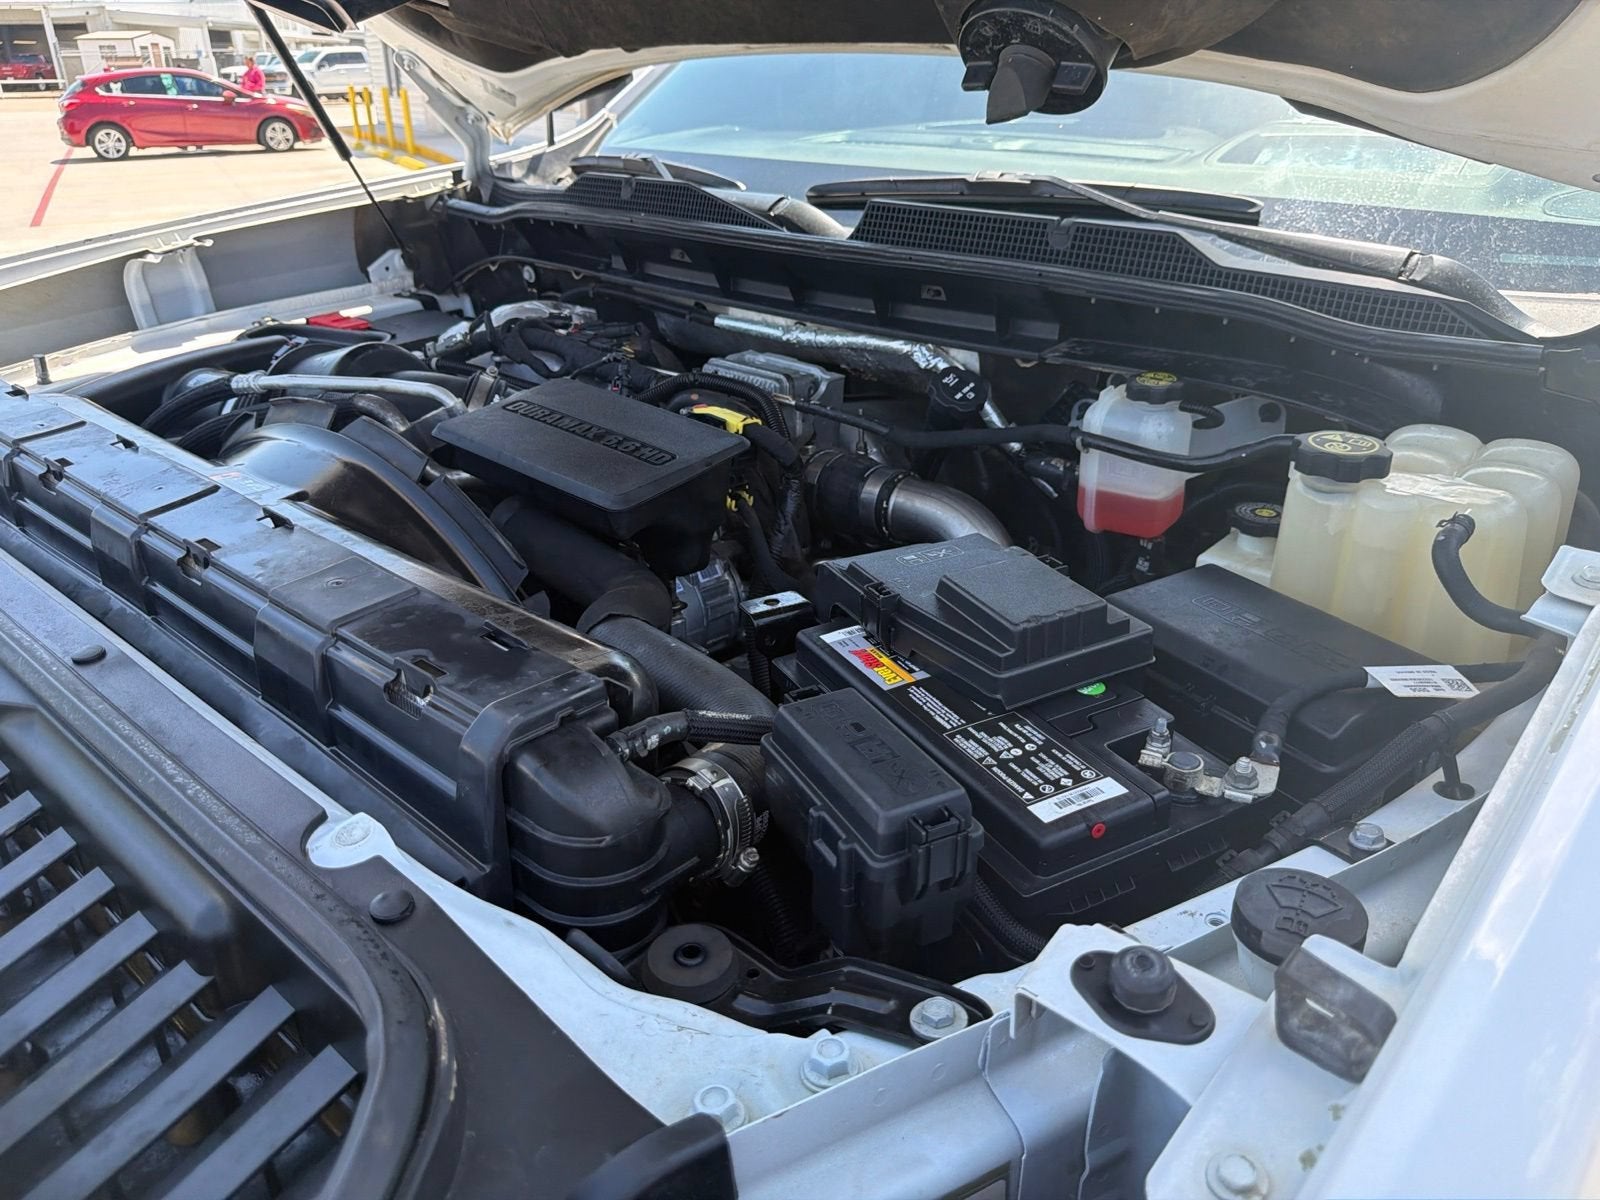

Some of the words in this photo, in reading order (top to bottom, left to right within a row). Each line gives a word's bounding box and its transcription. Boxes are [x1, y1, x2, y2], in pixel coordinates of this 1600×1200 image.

[506, 401, 600, 439] DURAMAX
[602, 434, 641, 453] 6.6
[848, 648, 904, 685] EverStart
